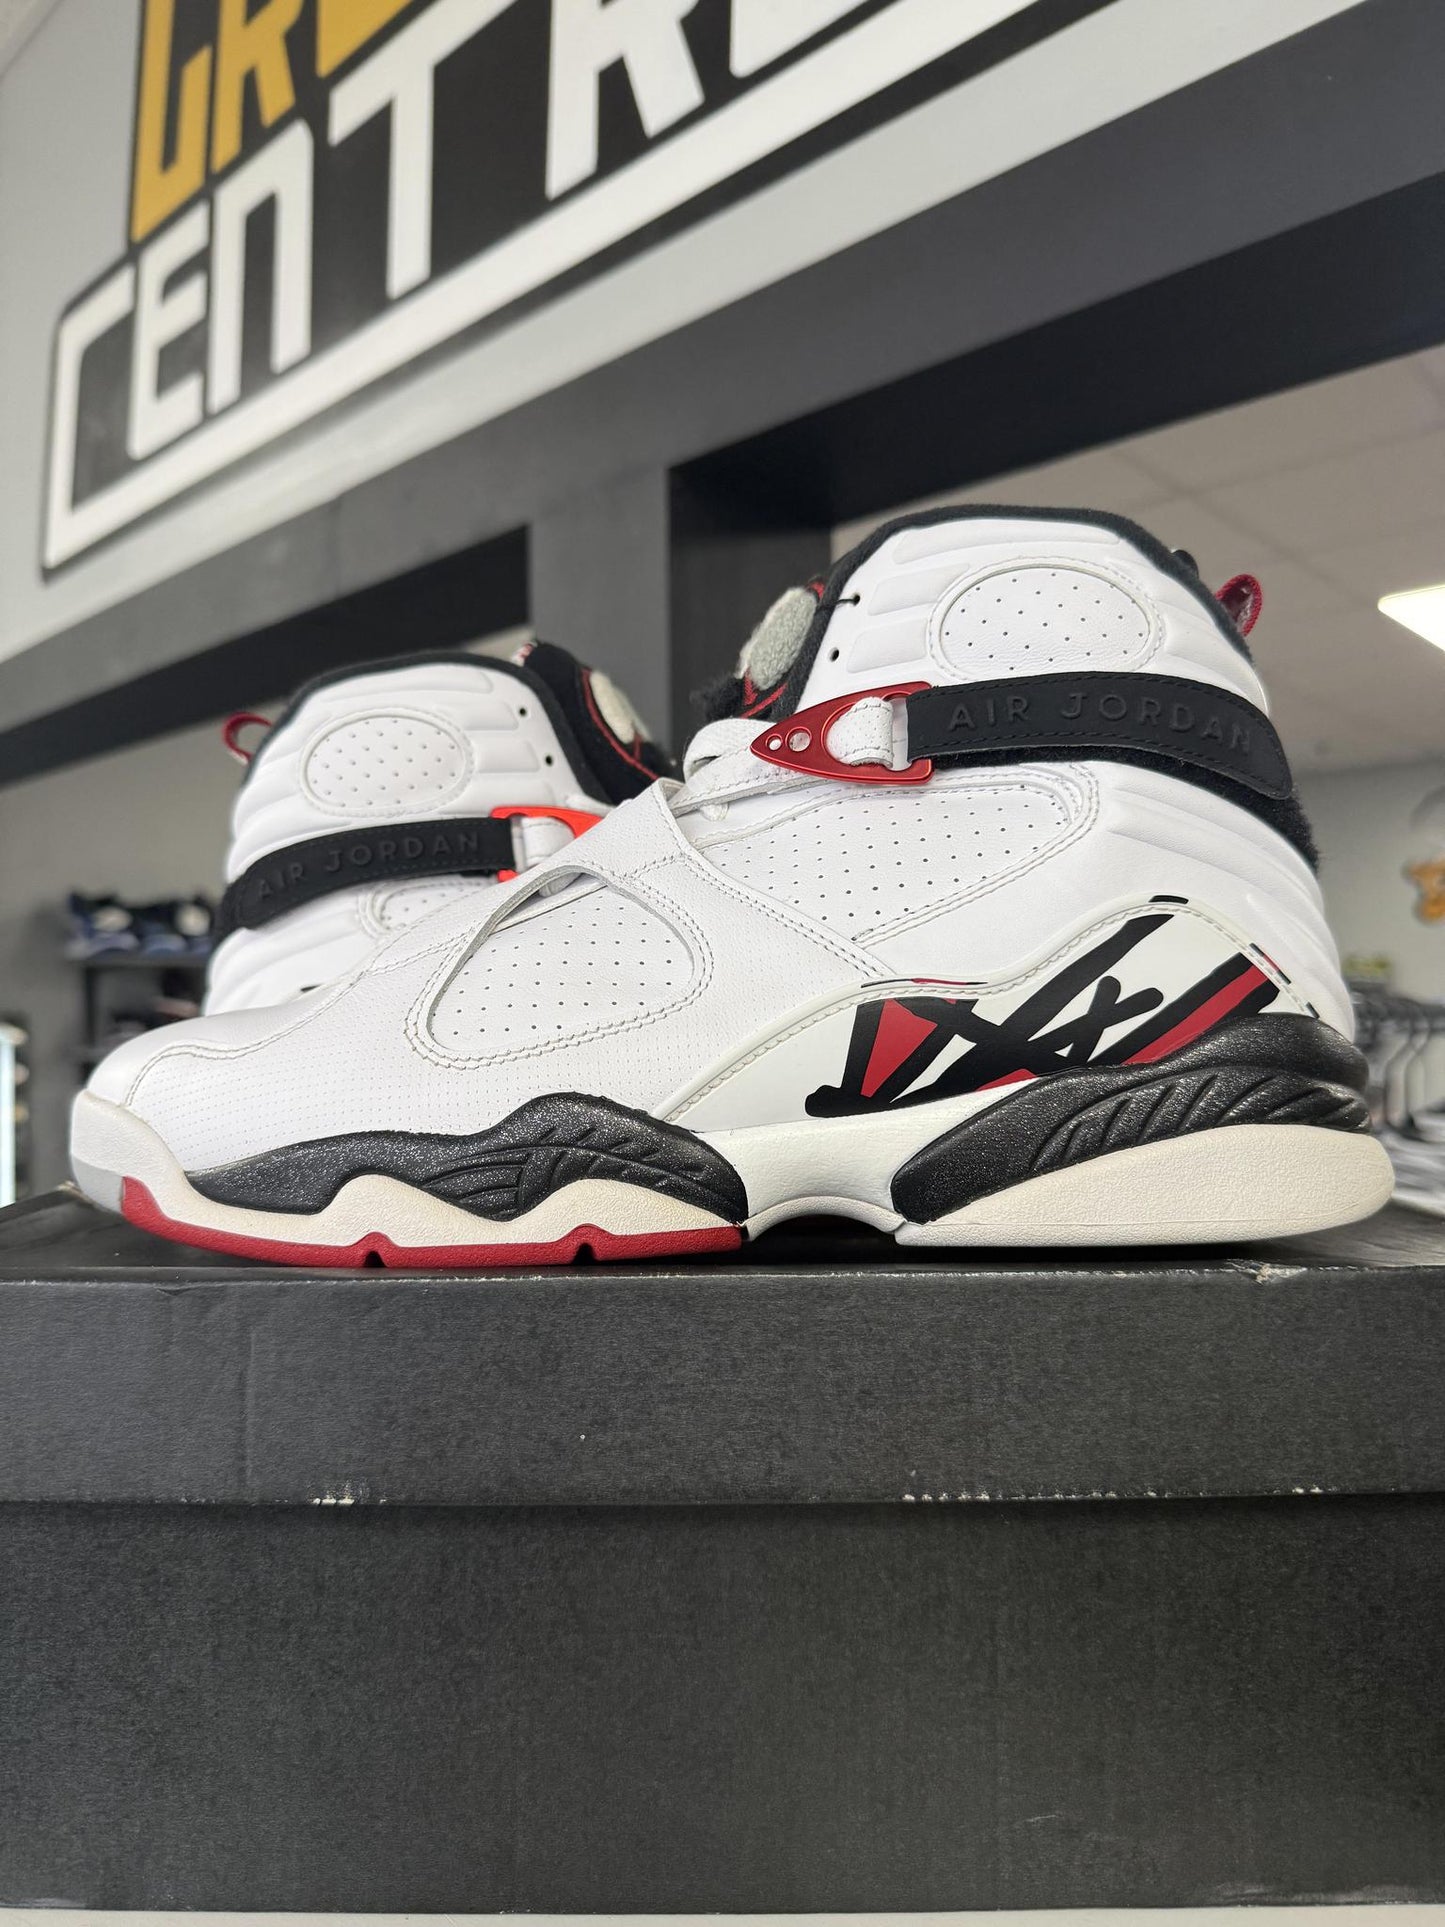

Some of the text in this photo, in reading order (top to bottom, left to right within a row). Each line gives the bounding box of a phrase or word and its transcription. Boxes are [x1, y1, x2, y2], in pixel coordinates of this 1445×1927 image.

[948, 692, 1254, 755] AIR JORDAN
[257, 831, 479, 899] AIR JORDAN
